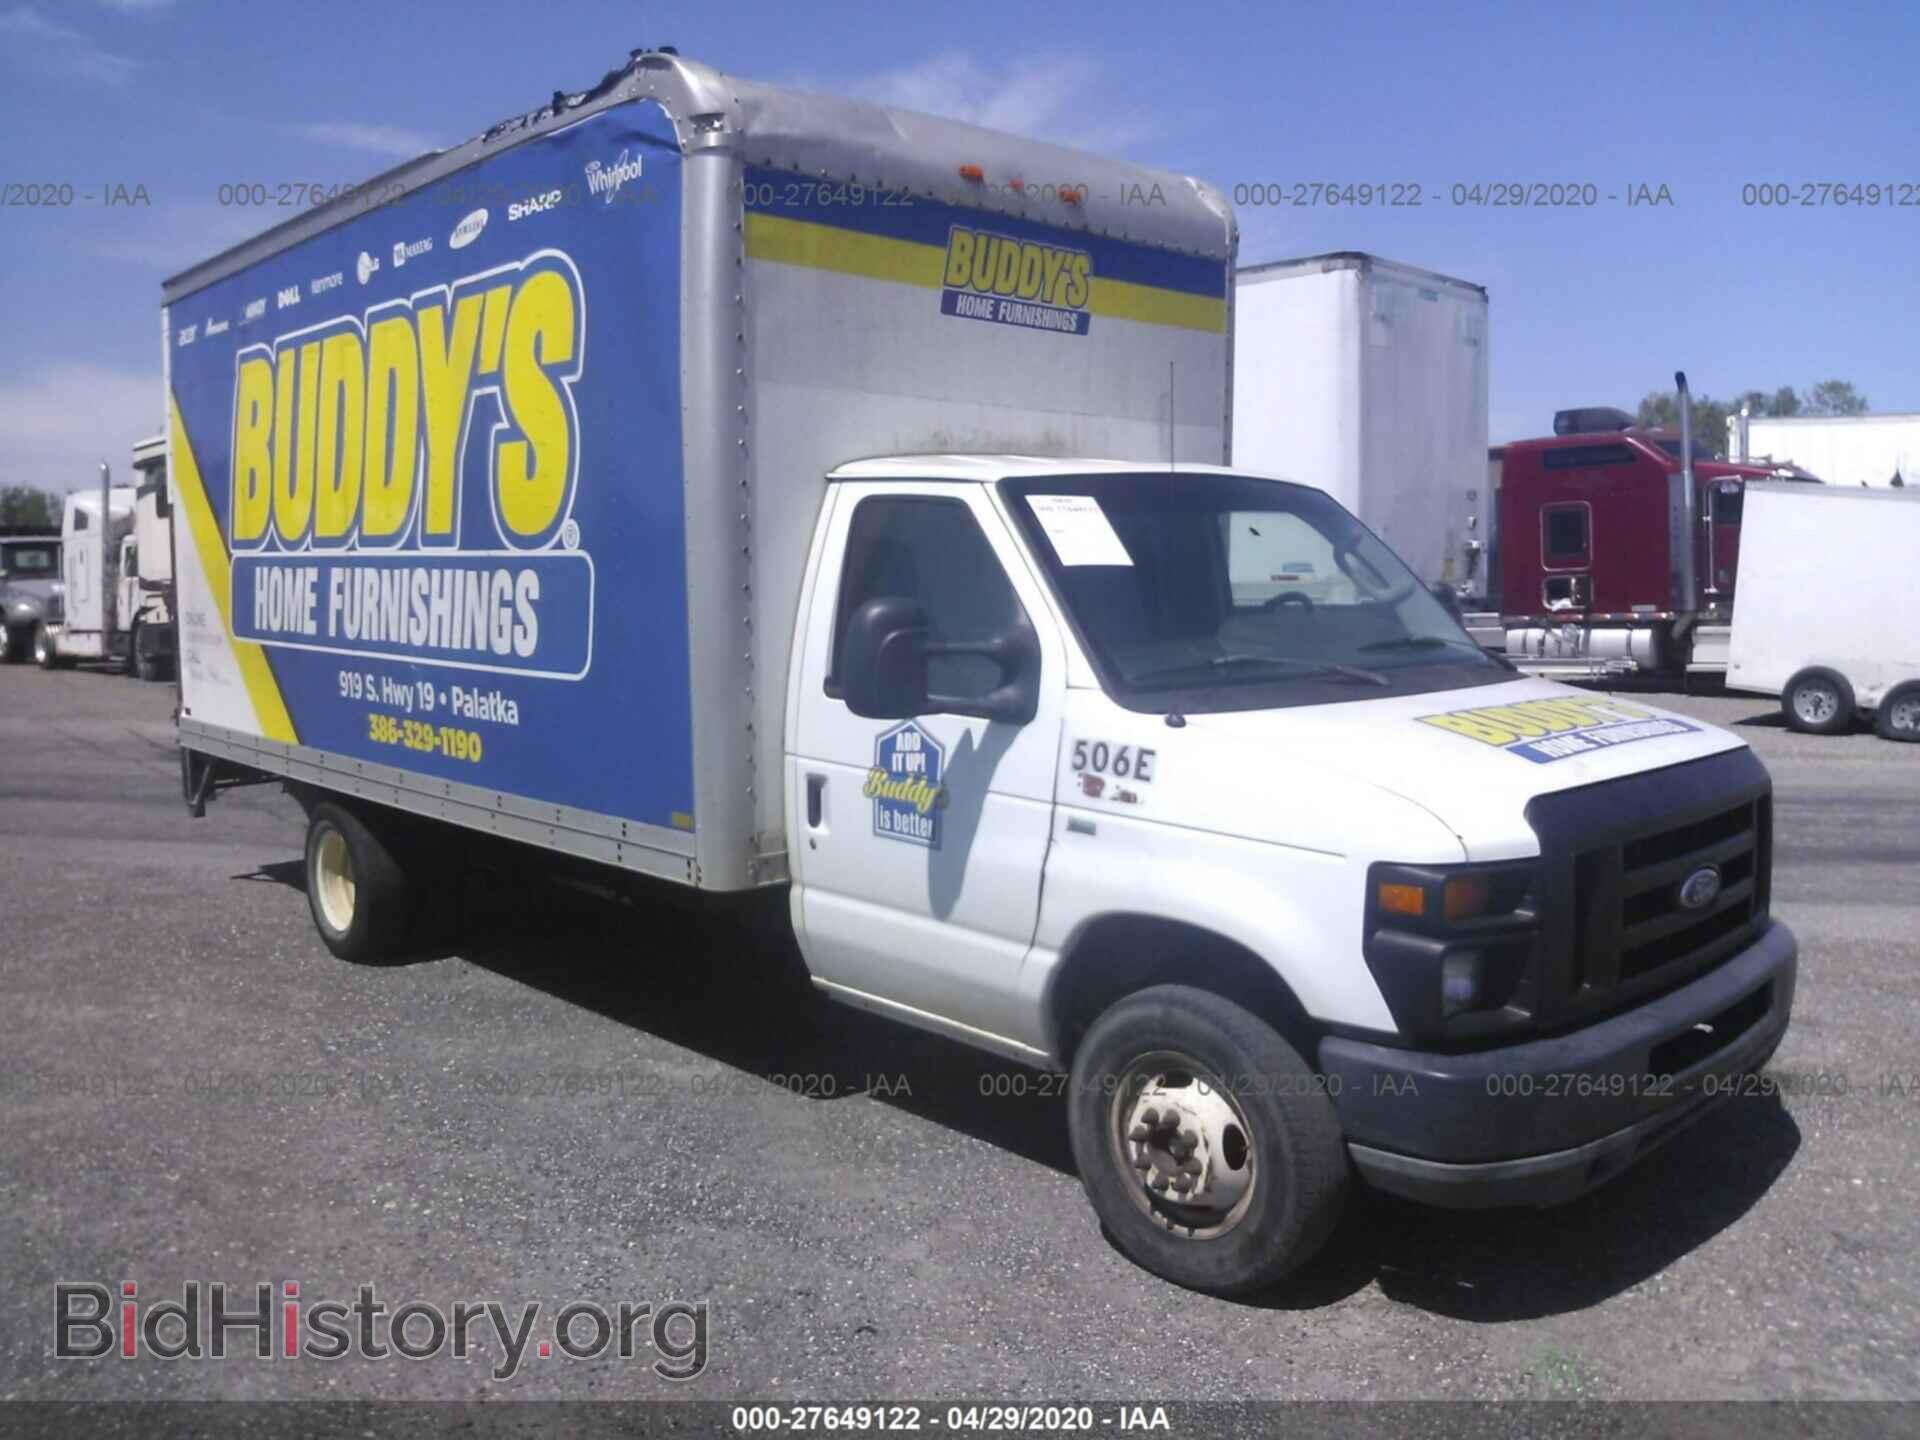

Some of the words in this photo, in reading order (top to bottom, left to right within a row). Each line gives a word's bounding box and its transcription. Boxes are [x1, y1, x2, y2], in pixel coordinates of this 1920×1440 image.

[586, 149, 643, 204] Whirlpool
[508, 190, 562, 221] SHARP
[945, 229, 1090, 308] BUDDY'S
[956, 294, 994, 319] HOME
[999, 302, 1078, 331] FURNISHINGS
[234, 271, 574, 541] BUDDY'S
[254, 566, 318, 635] HOME
[328, 567, 540, 657] FURNISHINGS
[339, 670, 362, 699] 919
[366, 674, 379, 703] S.
[382, 676, 414, 713] Hwy
[416, 681, 434, 711] 19
[452, 685, 519, 725] Palatka
[368, 713, 482, 763] 386-329-1190
[895, 732, 921, 752] ADD
[1072, 741, 1156, 782] 506E
[892, 752, 904, 772] IT
[863, 767, 949, 814] Buddy
[894, 809, 933, 838] better
